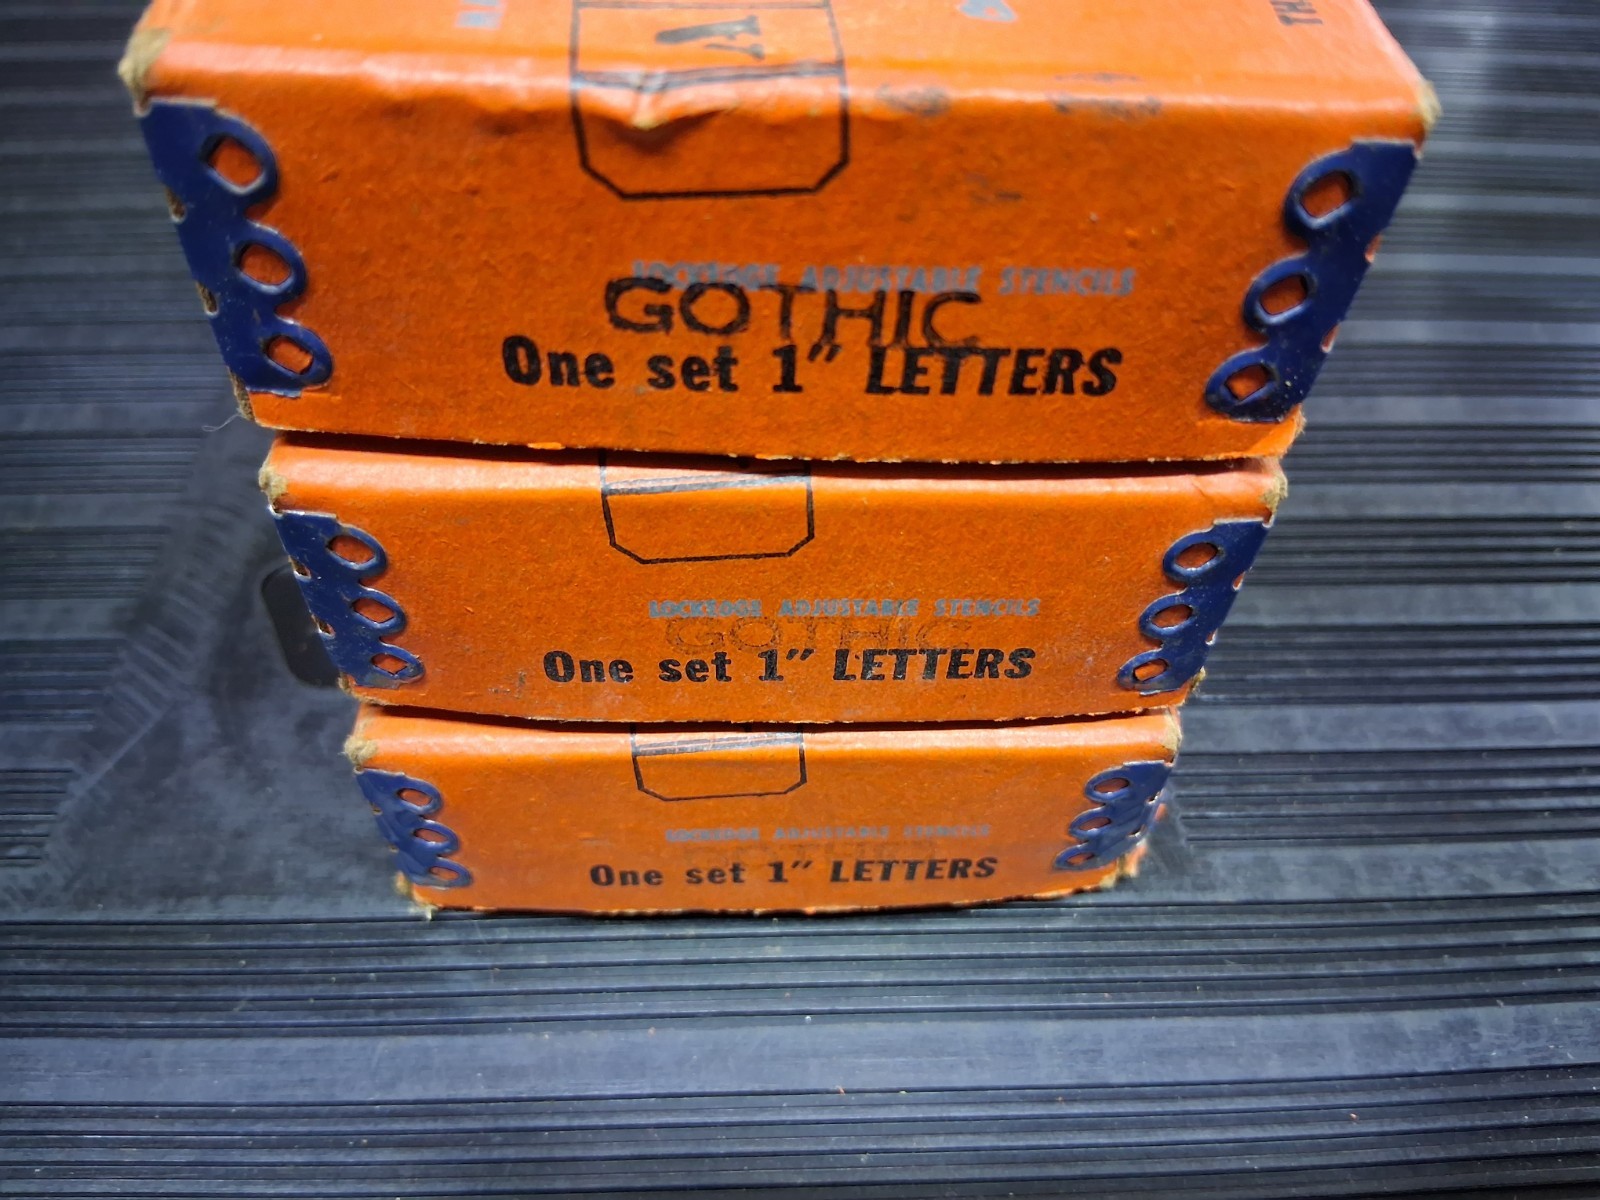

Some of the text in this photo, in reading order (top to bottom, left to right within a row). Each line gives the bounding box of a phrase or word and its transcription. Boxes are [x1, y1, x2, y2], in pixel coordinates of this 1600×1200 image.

[801, 265, 983, 293] ADJUSTABLE
[998, 267, 1136, 297] STENCILS
[605, 277, 982, 350] GOTHIC
[502, 335, 615, 387] One
[647, 346, 738, 392] set
[865, 346, 1123, 396] LETTERS
[778, 598, 920, 618] ADJUSTABLE
[933, 598, 1041, 616] STENCILS
[543, 650, 634, 684] One
[658, 651, 733, 683] set
[832, 648, 1036, 681] LETTERS
[589, 863, 664, 887] One
[685, 861, 745, 885] set
[830, 856, 998, 883] LETTERS
